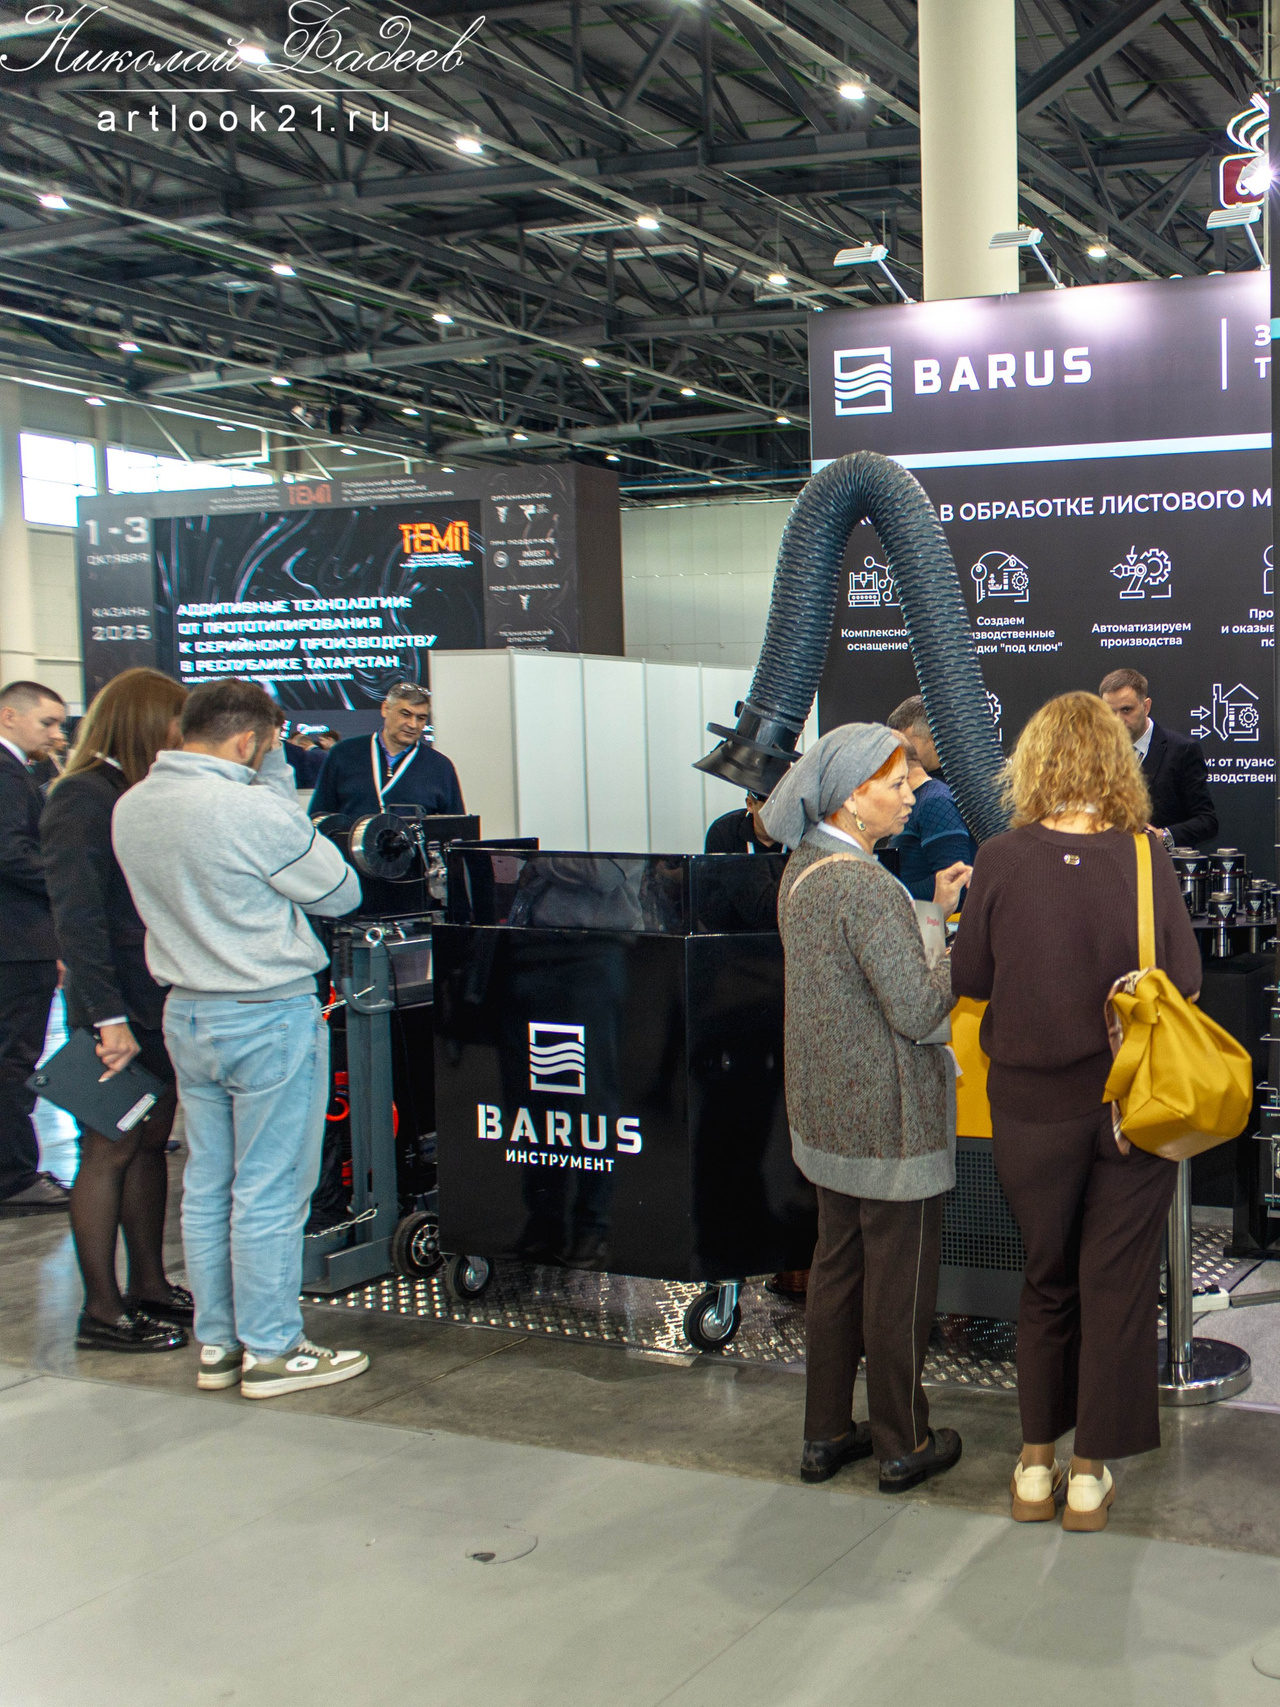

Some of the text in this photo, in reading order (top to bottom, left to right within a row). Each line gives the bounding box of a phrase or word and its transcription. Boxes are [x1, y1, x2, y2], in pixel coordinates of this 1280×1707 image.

[913, 346, 1092, 396] BARUS
[939, 504, 954, 523] В
[959, 496, 1094, 521] ОБРАБОТКЕ
[1100, 489, 1245, 515] ЛИСТОВОГО
[398, 520, 471, 554] ТЕМП
[91, 606, 151, 618] КАЗАНЬ
[176, 595, 413, 617] АДДИТИВНЫЕ ТЕХНОЛОГИИ:
[1249, 608, 1275, 621] Про
[177, 616, 383, 635] ОТ ПРОТОТИПИРОВАНИЯ
[976, 616, 1025, 627] Создаем
[91, 624, 152, 641] 2025
[841, 627, 910, 638] Комплексно
[1091, 622, 1192, 635] Автоматизируем
[1221, 625, 1229, 634] и
[195, 637, 297, 654] СЕРИЙНОМУ
[299, 634, 438, 651] ПРОИЗВОДСТВУ
[847, 642, 909, 651] оснащение
[976, 642, 1063, 654] дки "под ключ"
[1100, 636, 1183, 649] производства
[195, 657, 302, 673] РЕСПУБЛИКЕ
[303, 655, 400, 670] ТАТАРСТАН
[1218, 758, 1233, 767] от
[1236, 758, 1276, 769] пуанс
[1206, 773, 1277, 784] зводствен
[477, 1102, 643, 1155] BARUS
[505, 1148, 615, 1172] ИНСТРУМЕНТ
